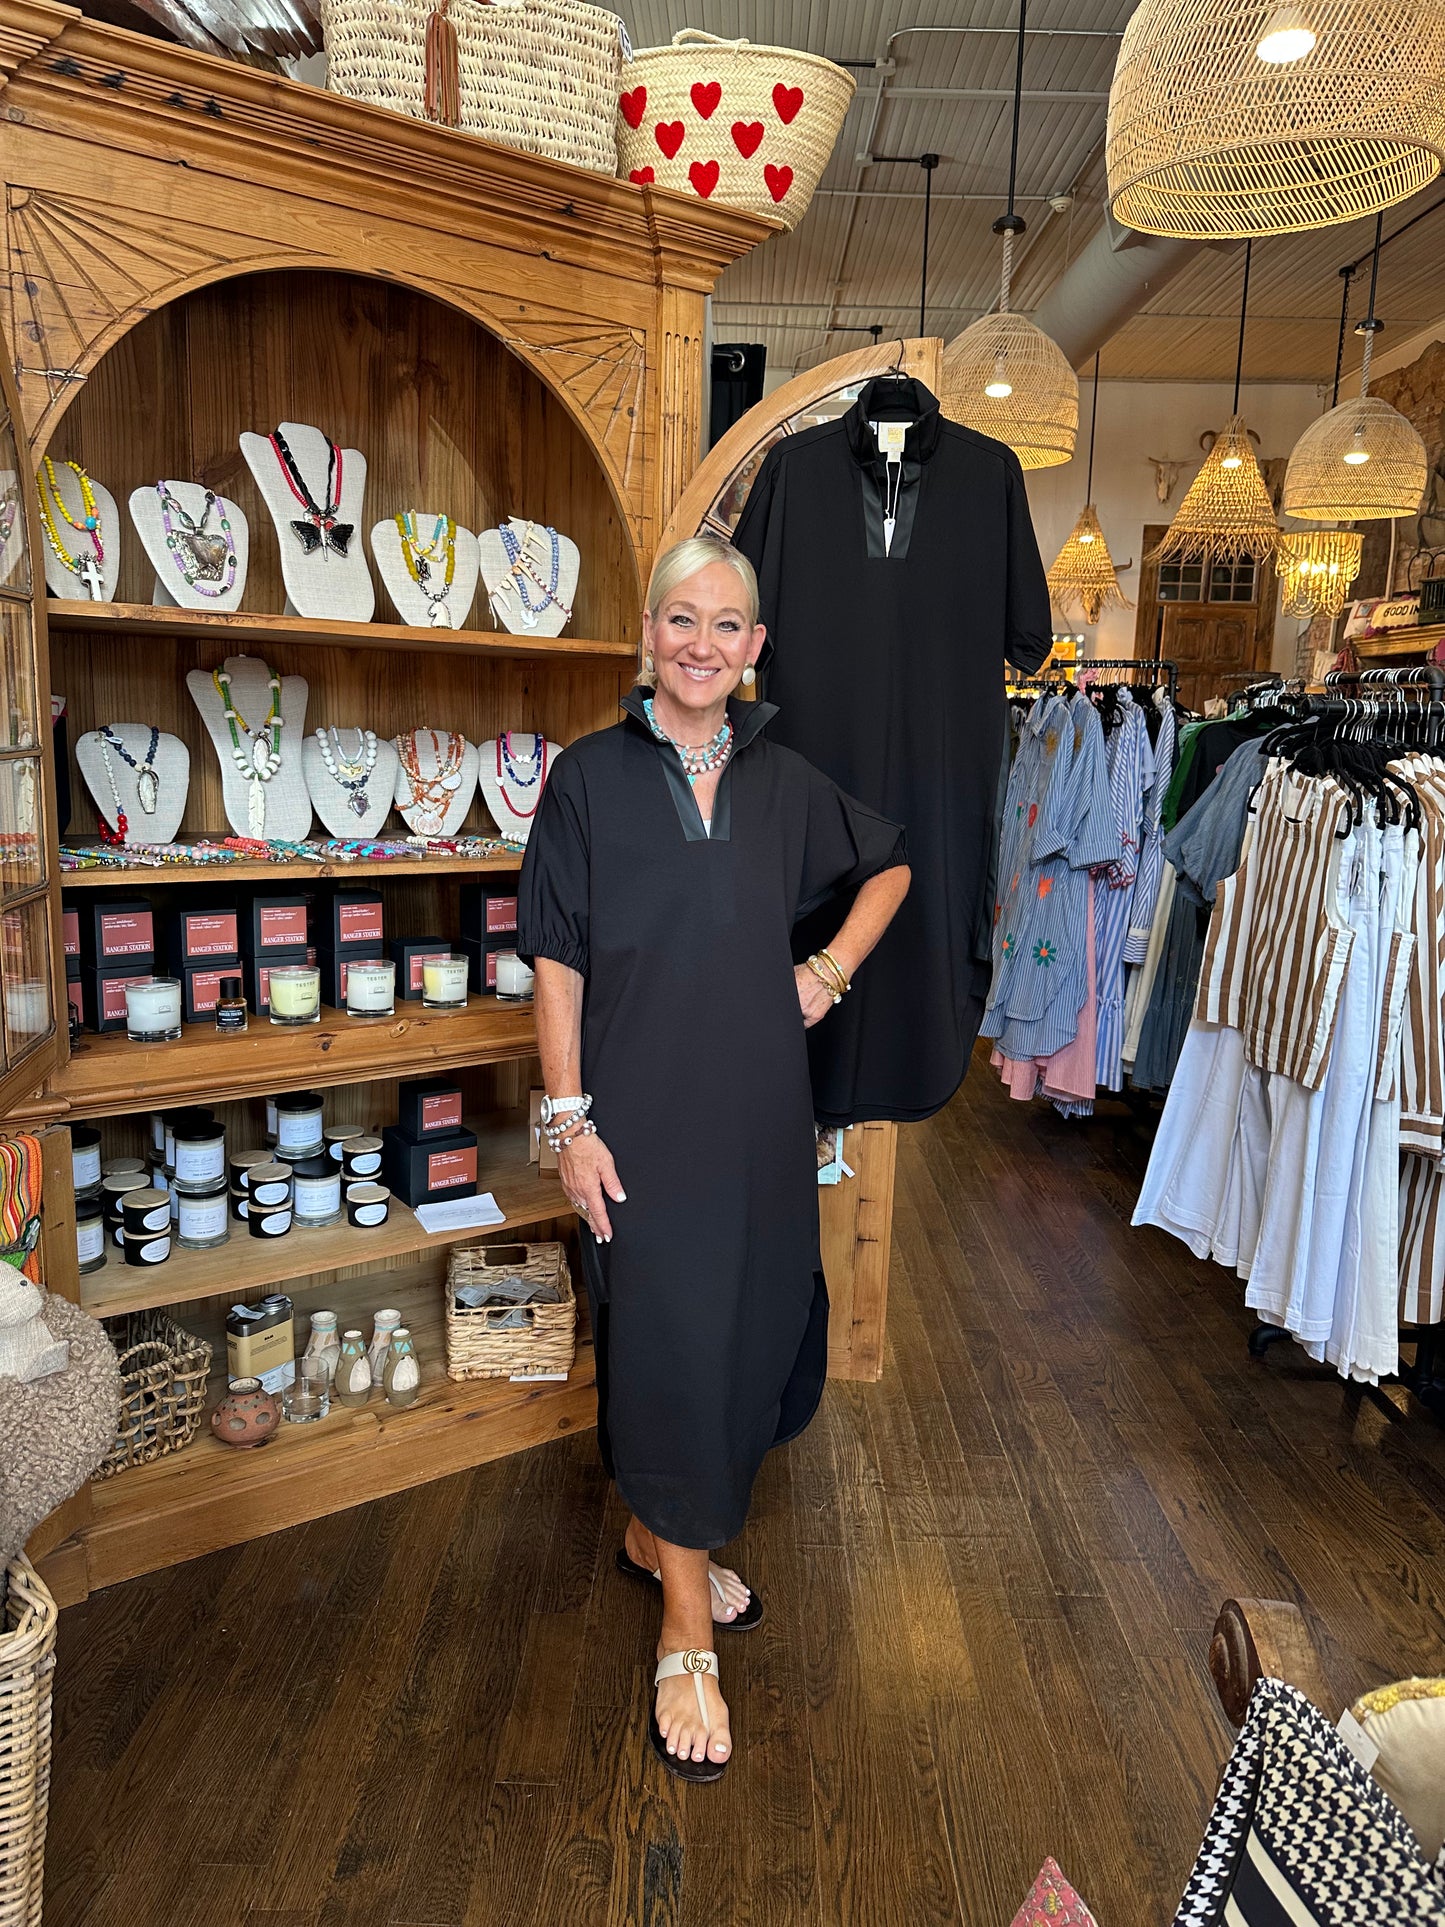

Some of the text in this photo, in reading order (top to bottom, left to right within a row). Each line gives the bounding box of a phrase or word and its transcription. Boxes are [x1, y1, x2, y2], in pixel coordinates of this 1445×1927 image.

[1383, 605, 1409, 617] GOOD
[362, 930, 381, 938] STATION
[284, 935, 305, 943] STATION
[105, 943, 151, 953] RANGER STATION
[190, 945, 212, 953] RANGER
[212, 943, 234, 952] STATION
[296, 980, 315, 988] TESTER
[424, 1120, 441, 1128] RANGER
[431, 1176, 467, 1188] RANGER STATION
